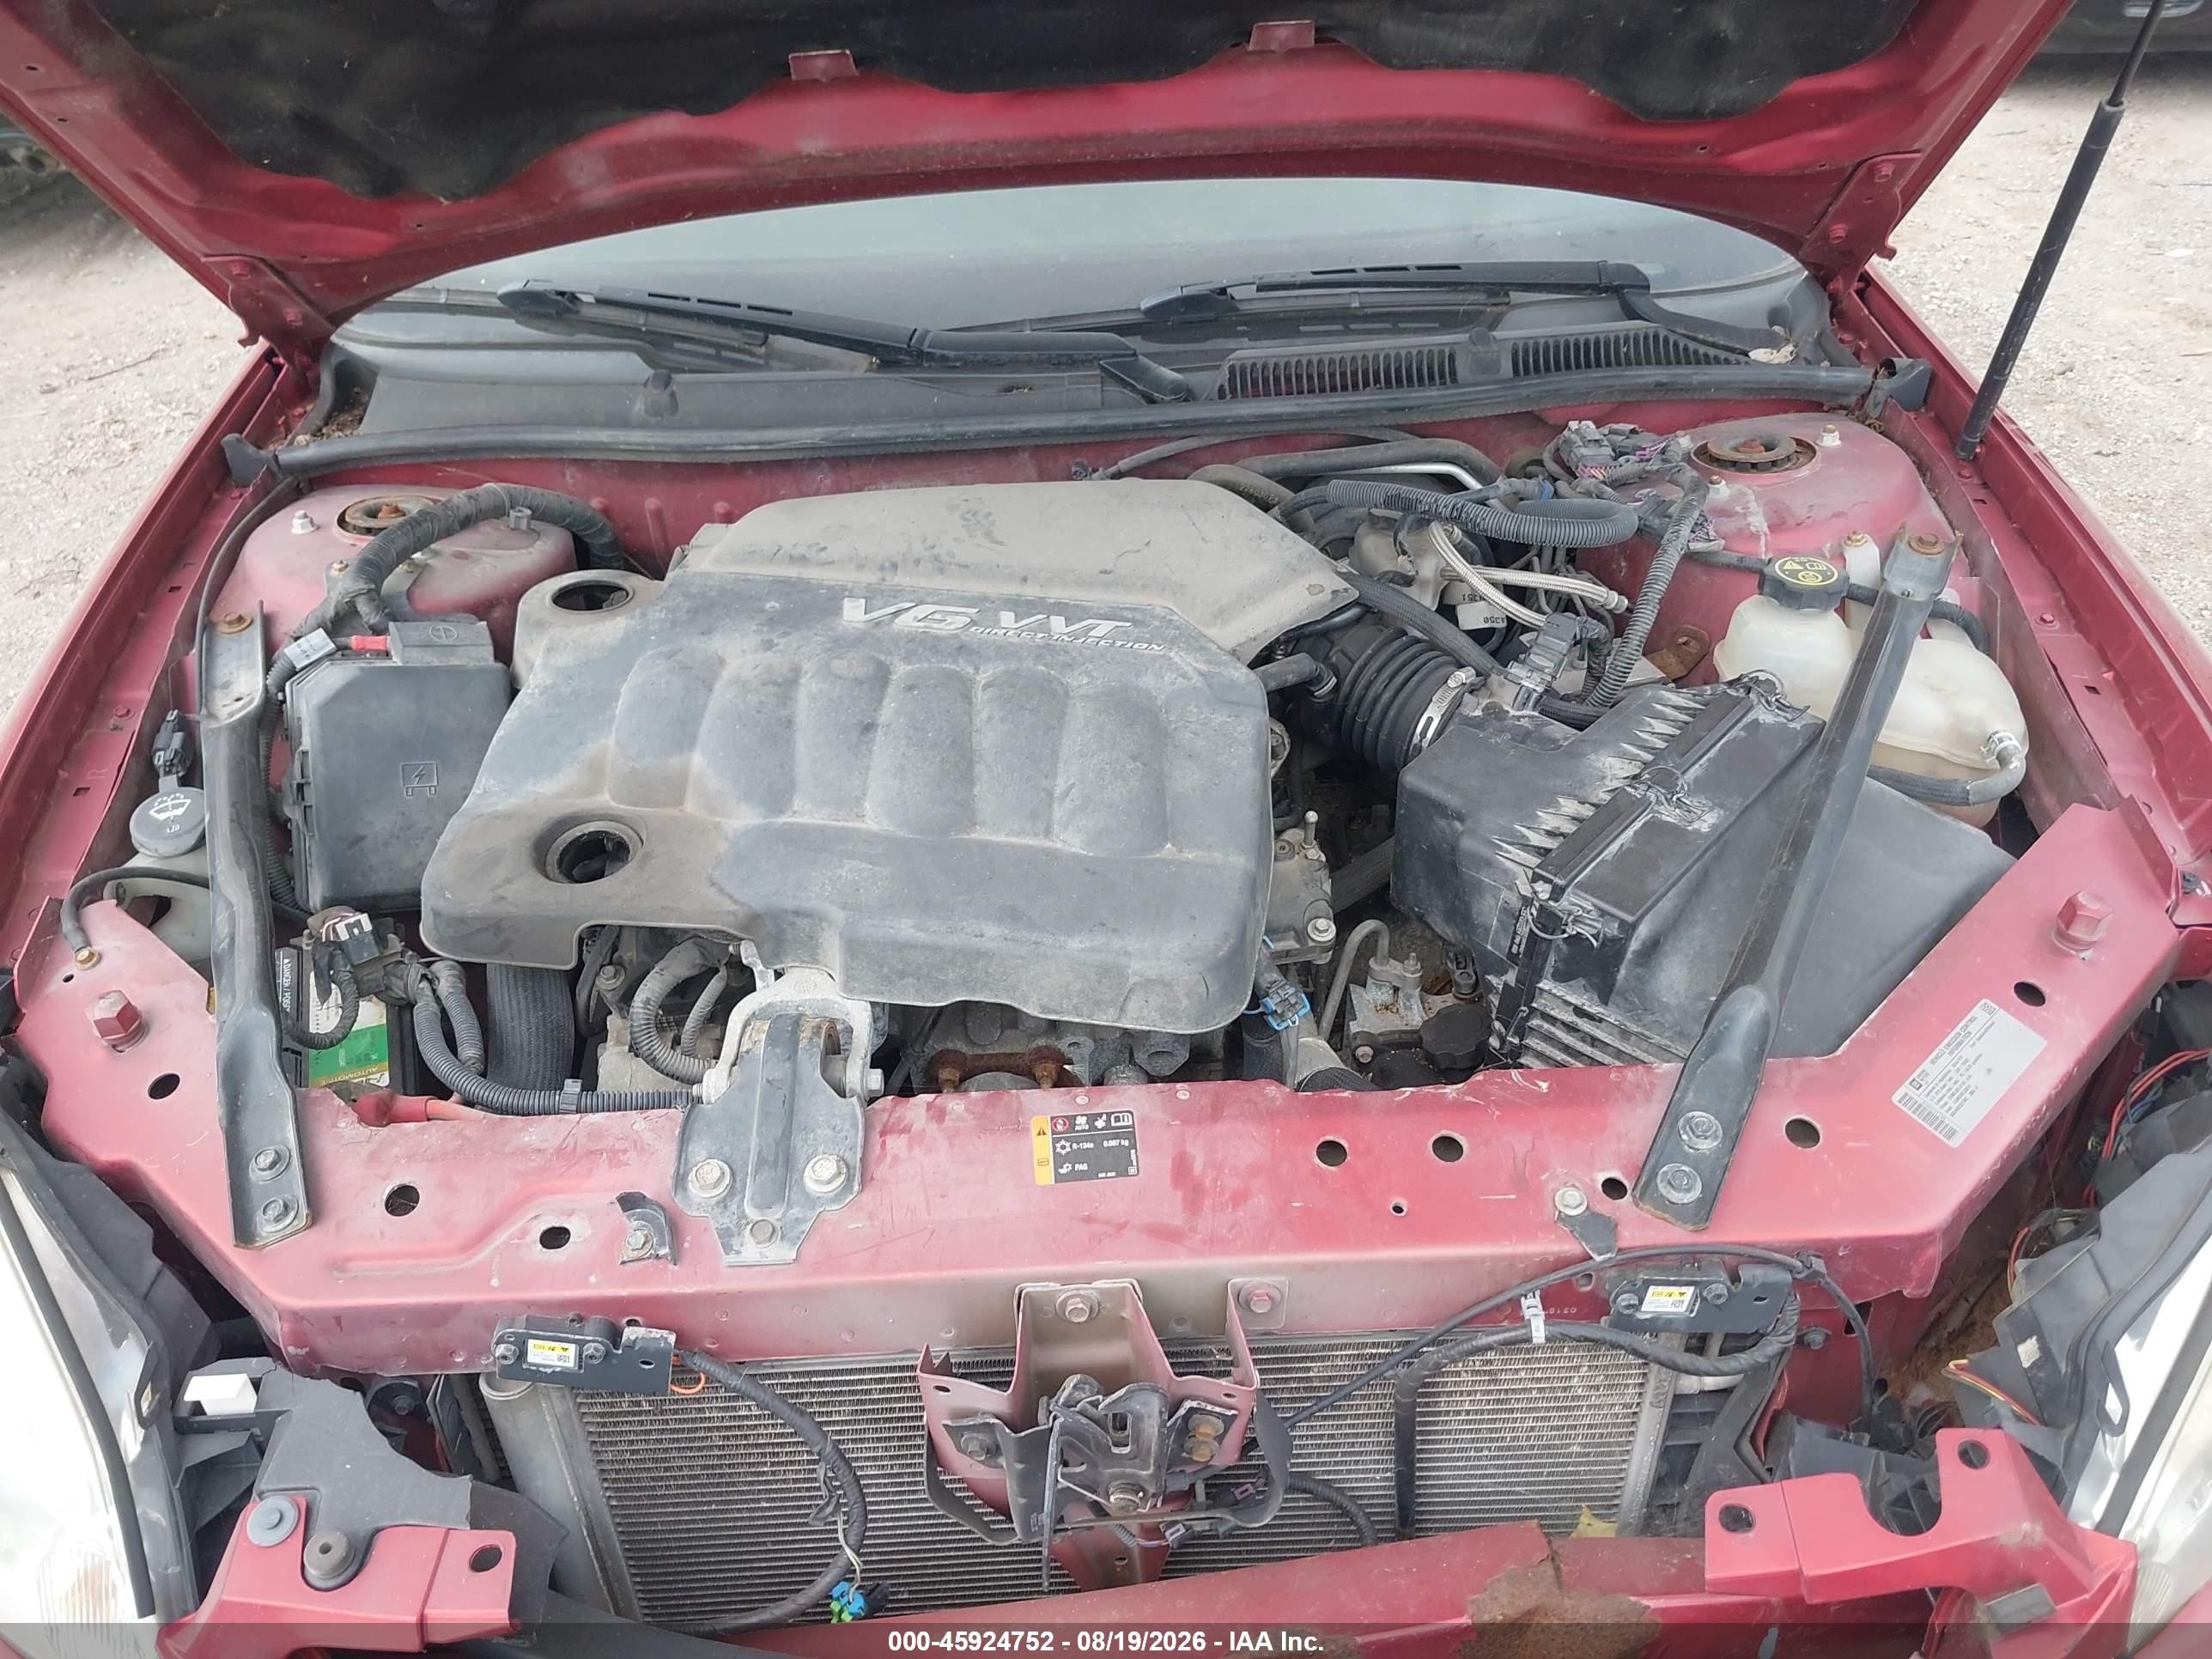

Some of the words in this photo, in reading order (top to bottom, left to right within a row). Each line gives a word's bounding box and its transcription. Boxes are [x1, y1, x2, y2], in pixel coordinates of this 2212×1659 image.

[843, 598, 981, 630] V6
[1000, 611, 1134, 638] VVT
[969, 626, 1049, 640] DIRECT
[1050, 634, 1164, 652] INJECTION
